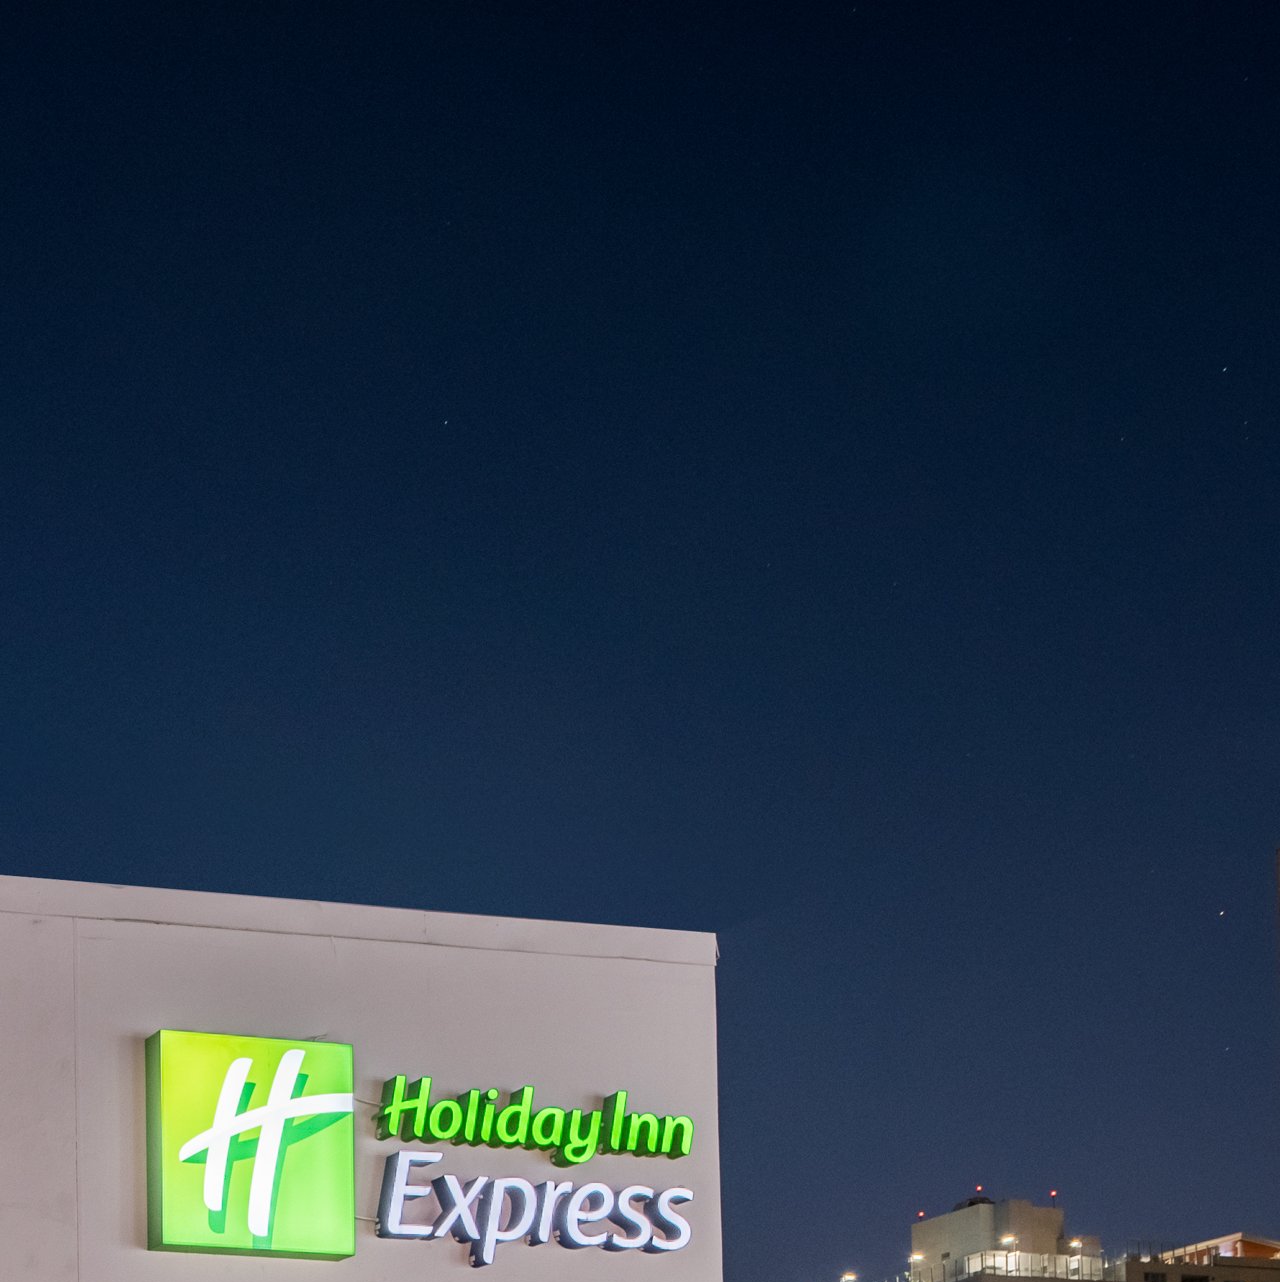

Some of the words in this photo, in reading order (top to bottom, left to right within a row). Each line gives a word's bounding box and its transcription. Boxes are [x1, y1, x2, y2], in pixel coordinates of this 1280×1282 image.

[378, 1074, 601, 1165] Holiday
[604, 1089, 695, 1157] Inn
[380, 1149, 695, 1267] Express
